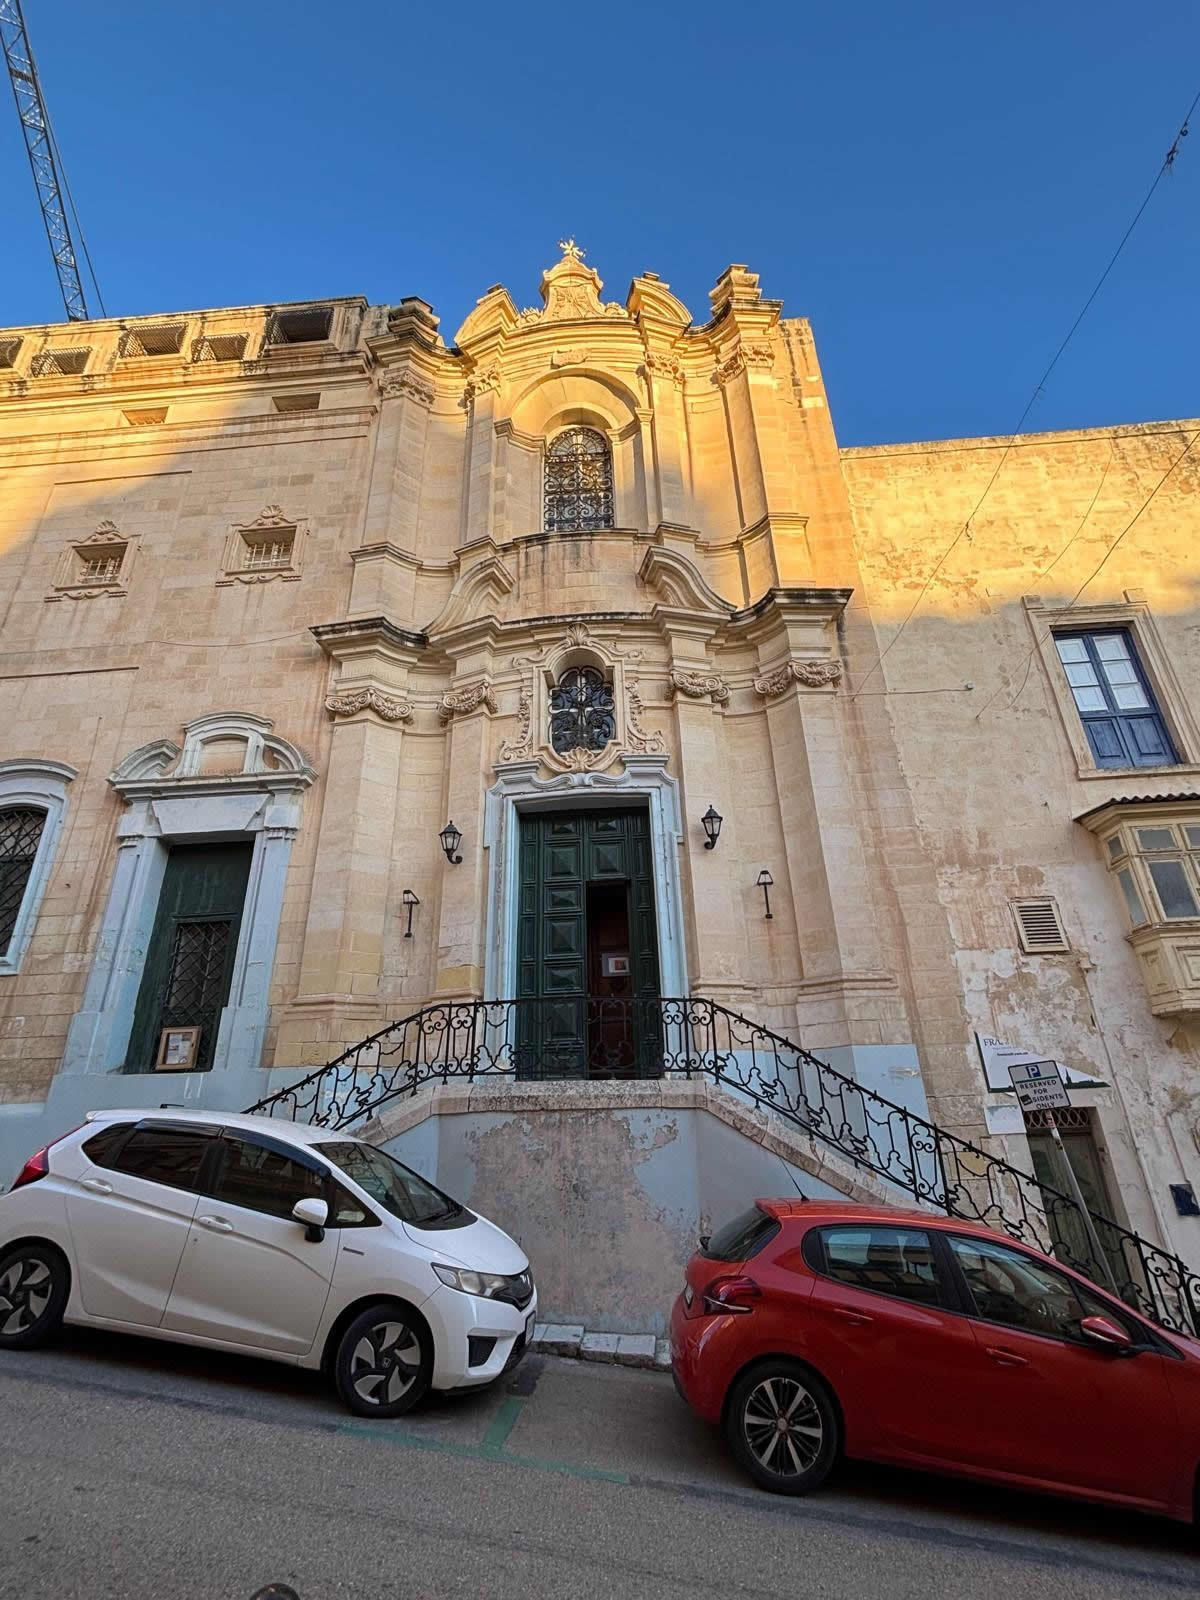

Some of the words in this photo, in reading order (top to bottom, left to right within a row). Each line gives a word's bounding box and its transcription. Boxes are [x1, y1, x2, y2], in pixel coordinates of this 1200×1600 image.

[984, 1038, 1004, 1046] FRA
[1028, 1066, 1038, 1078] P
[1020, 1080, 1057, 1090] RESERVED
[1031, 1093, 1064, 1103] SIDENTS
